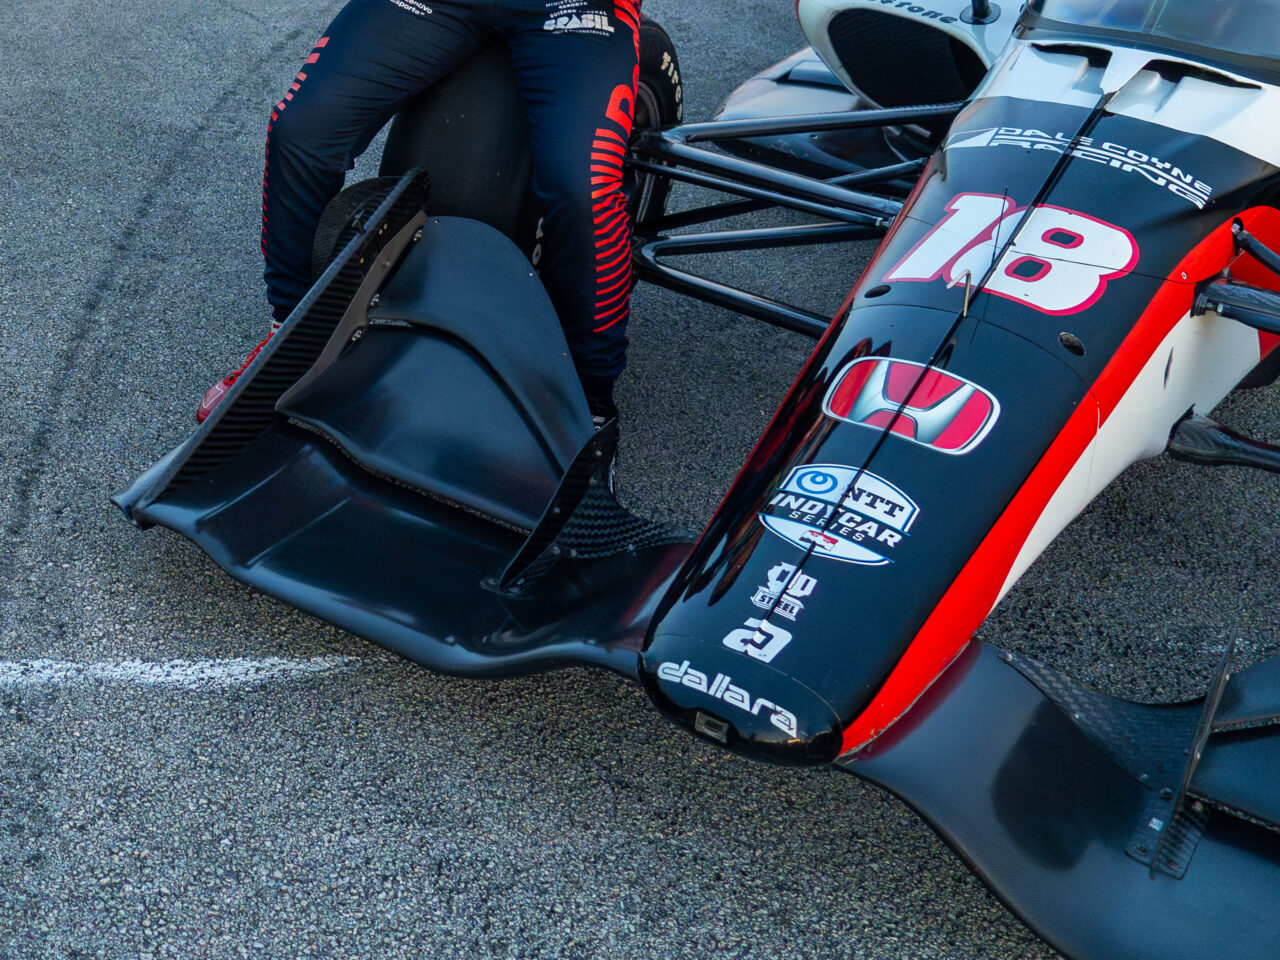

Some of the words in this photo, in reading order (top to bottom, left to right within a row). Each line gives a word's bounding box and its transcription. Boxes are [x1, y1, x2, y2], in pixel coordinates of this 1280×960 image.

[543, 14, 615, 33] BRASIL
[989, 141, 1209, 210] RACING
[997, 127, 1094, 147] DALE
[1102, 142, 1213, 195] COYNE
[883, 192, 1140, 317] 18
[769, 493, 903, 548] INDYCAR
[789, 510, 867, 542] SERIES
[842, 485, 905, 518] NTT
[758, 594, 796, 615] STEEL
[657, 660, 798, 739] dallara
